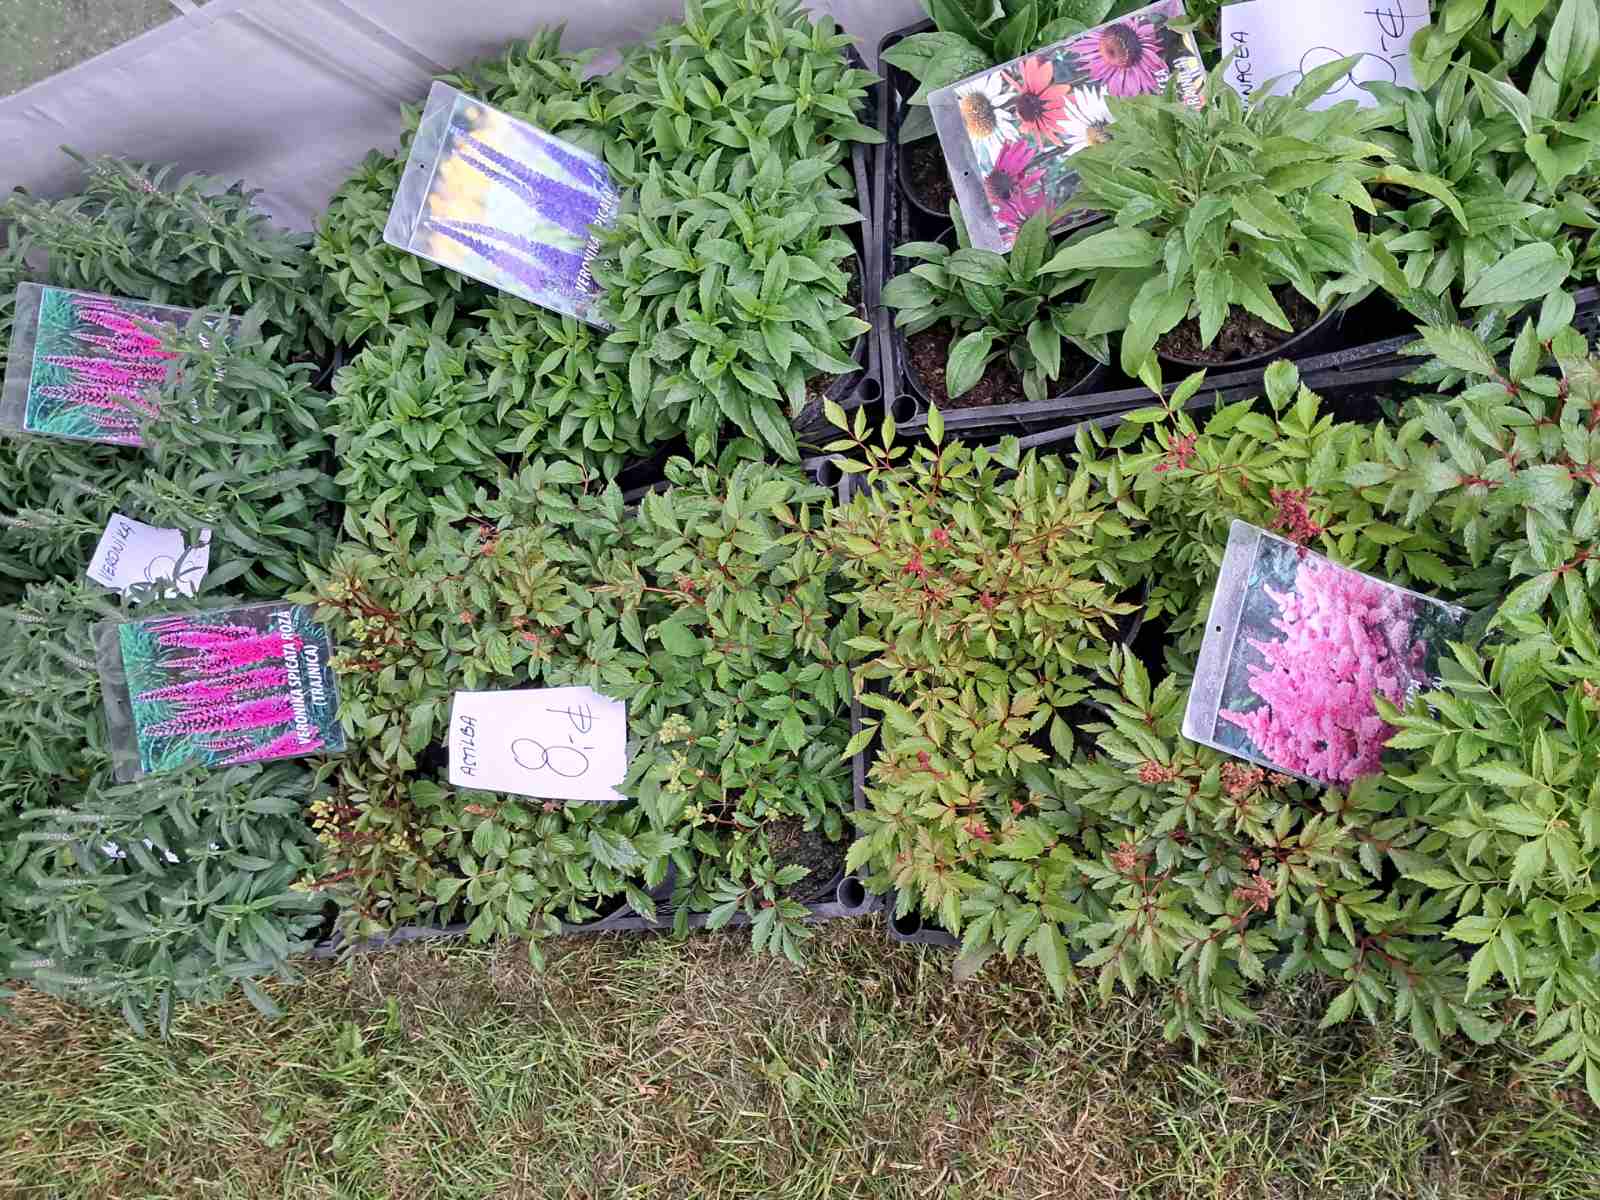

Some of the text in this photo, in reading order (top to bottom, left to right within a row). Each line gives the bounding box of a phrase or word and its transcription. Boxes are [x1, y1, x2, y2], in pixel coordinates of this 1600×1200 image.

[1231, 31, 1252, 111] NACEA
[593, 191, 616, 225] PICATA
[97, 521, 137, 582] VERONIKA
[278, 610, 311, 745] VERONIKA SPICATA ROZA
[303, 644, 328, 706] (TRAJNICA)
